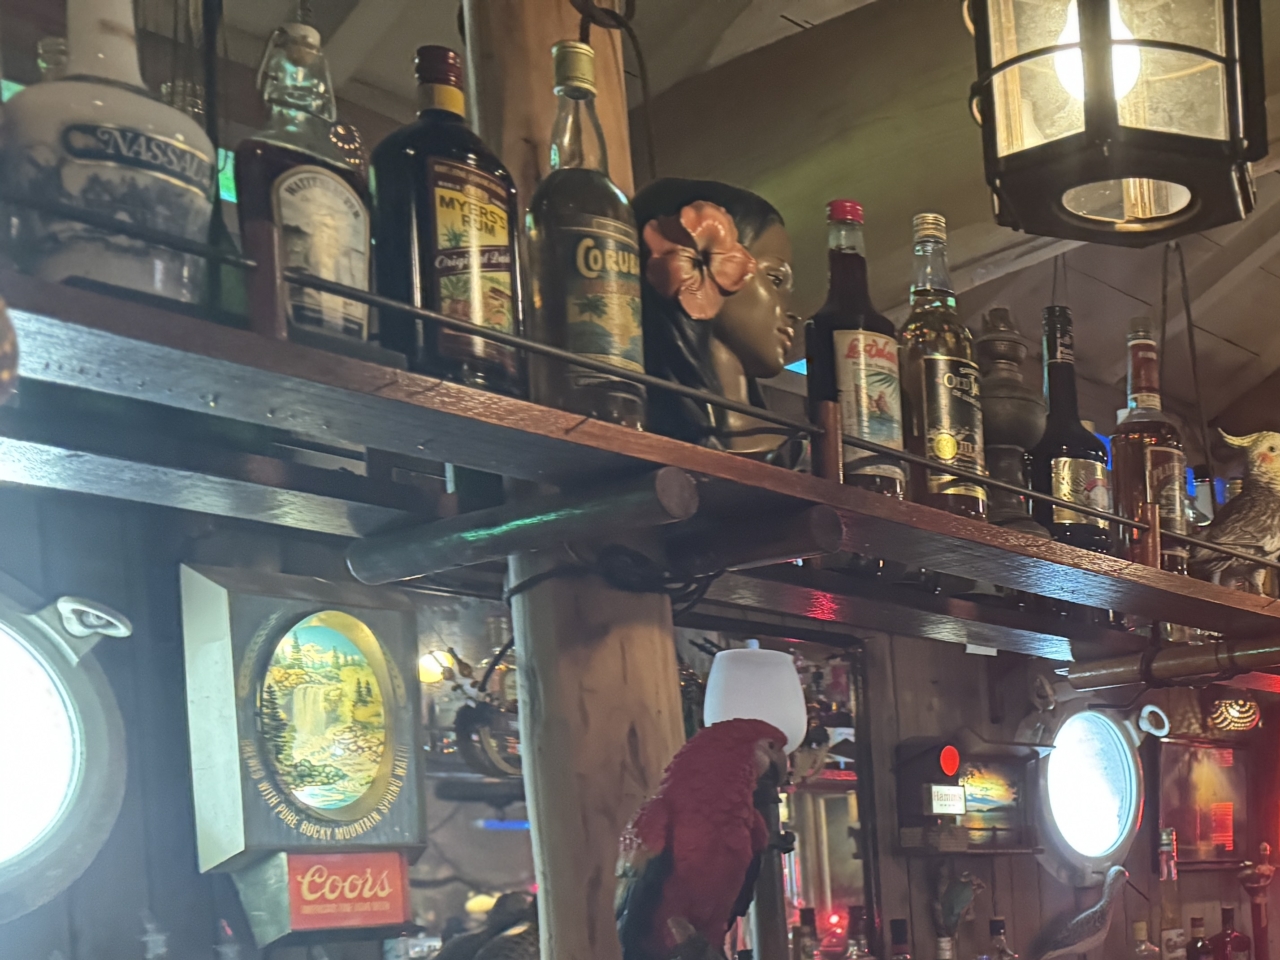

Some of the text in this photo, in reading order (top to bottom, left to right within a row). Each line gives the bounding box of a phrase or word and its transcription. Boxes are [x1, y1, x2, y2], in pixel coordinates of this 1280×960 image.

[257, 781, 281, 808] WITH
[275, 803, 300, 829] PURE
[300, 821, 332, 840] ROCKY
[334, 811, 382, 840] MOUNTAIN
[377, 778, 403, 814] SPRING
[295, 864, 393, 901] Coors
